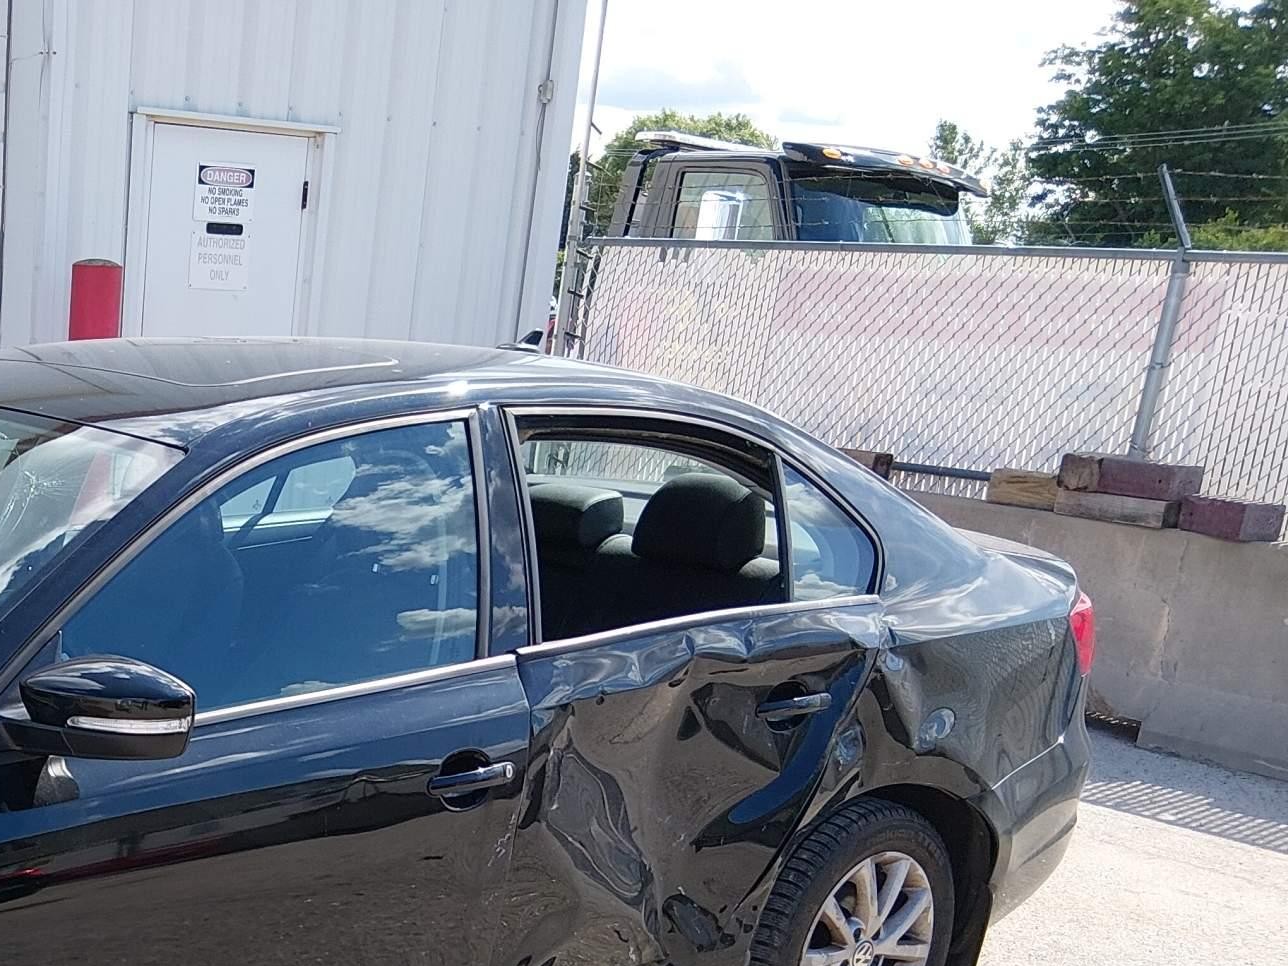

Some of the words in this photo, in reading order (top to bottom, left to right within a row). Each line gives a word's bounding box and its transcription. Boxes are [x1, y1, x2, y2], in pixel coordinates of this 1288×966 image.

[206, 170, 247, 184] DANGER
[208, 187, 216, 195] NO
[218, 187, 243, 197] SMOKING
[200, 195, 209, 204] NO
[210, 197, 225, 206] OPEN
[226, 198, 249, 208] FLAMES
[208, 206, 217, 215] NO
[218, 207, 240, 217] SPARKS
[197, 236, 246, 250] AUTHORIZED
[197, 252, 243, 266] PERSONNEL
[209, 269, 230, 281] ONLY
